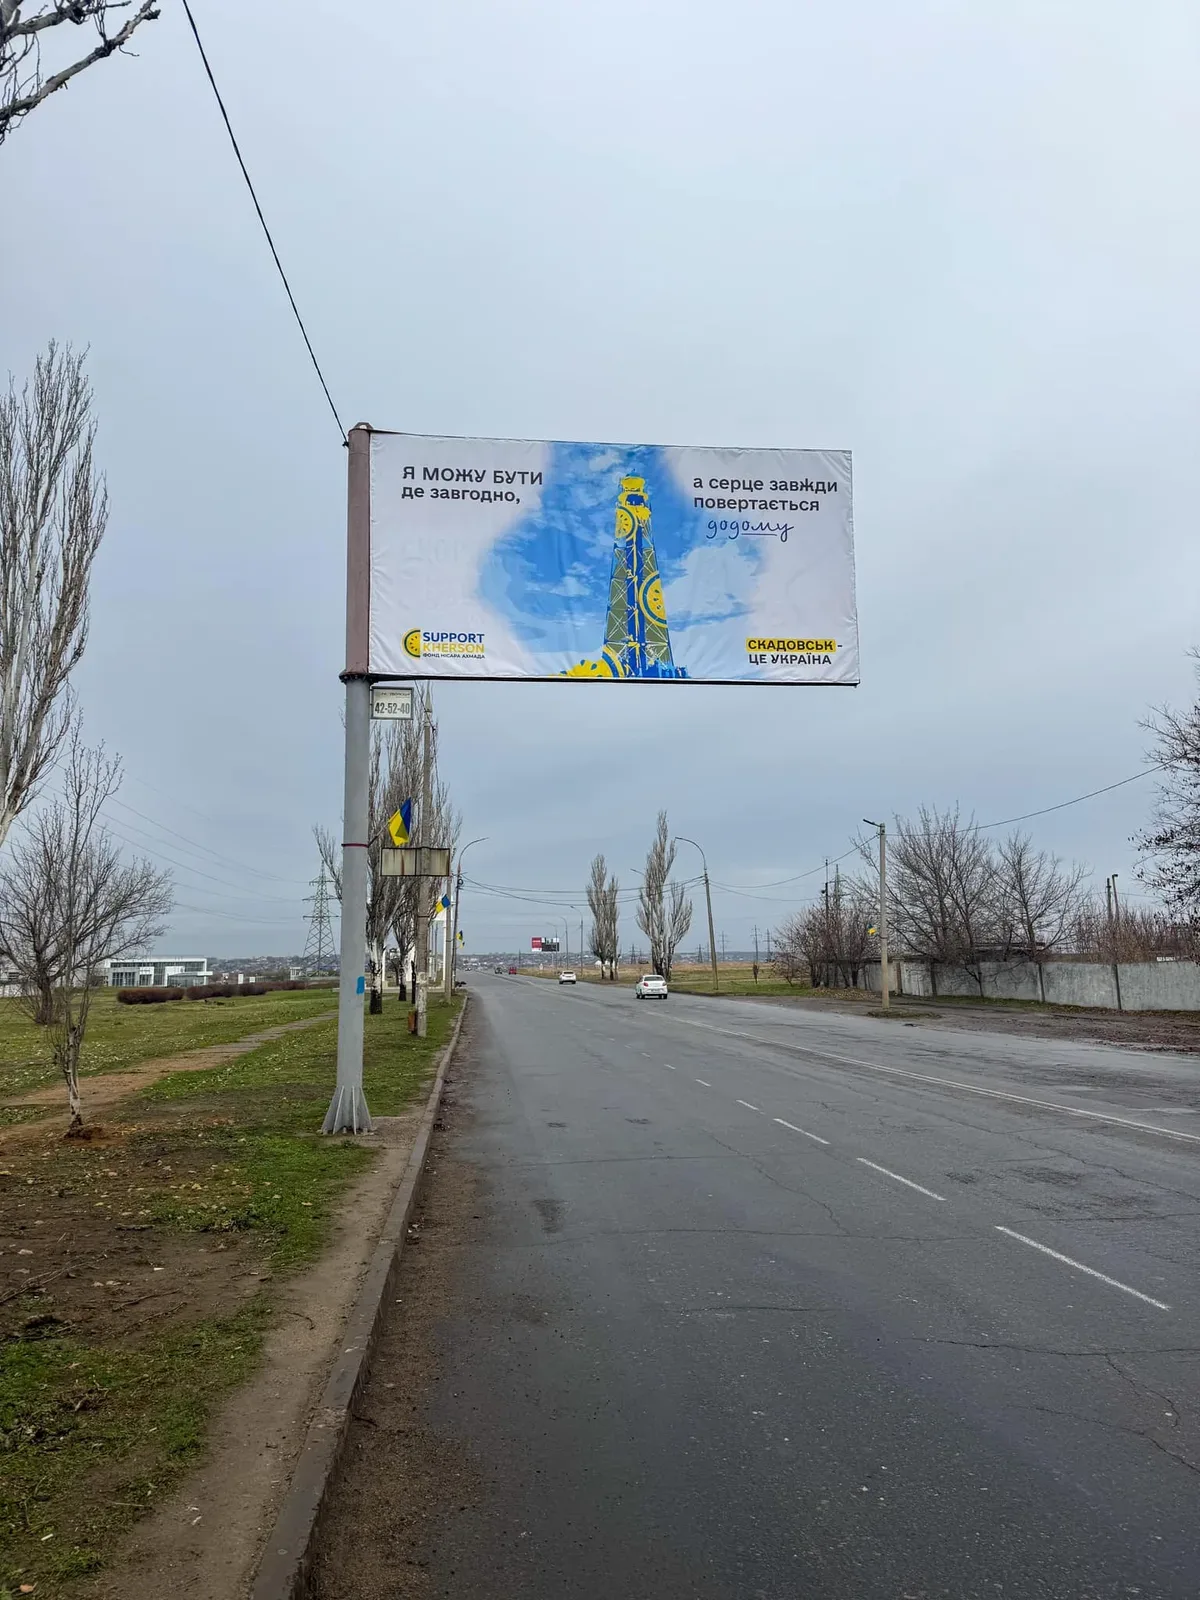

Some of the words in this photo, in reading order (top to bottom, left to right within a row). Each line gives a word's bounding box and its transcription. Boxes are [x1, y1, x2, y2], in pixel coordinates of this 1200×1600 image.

[402, 466, 415, 480] Я
[422, 466, 486, 483] МОЖУ
[493, 470, 543, 485] БУТИ
[693, 477, 703, 489] а
[708, 478, 764, 493] серце
[769, 478, 838, 494] завжди
[401, 486, 425, 500] де
[430, 487, 521, 504] завгодно,
[694, 497, 820, 512] повертається
[705, 519, 795, 542] додому
[423, 632, 485, 643] SUPPORT
[423, 643, 485, 653] KHERSON
[747, 639, 834, 652] СКАДОВСЬК
[748, 654, 767, 666] ЦЕ
[770, 652, 832, 665] УКРАЇНА
[374, 701, 410, 715] 42-52-40
